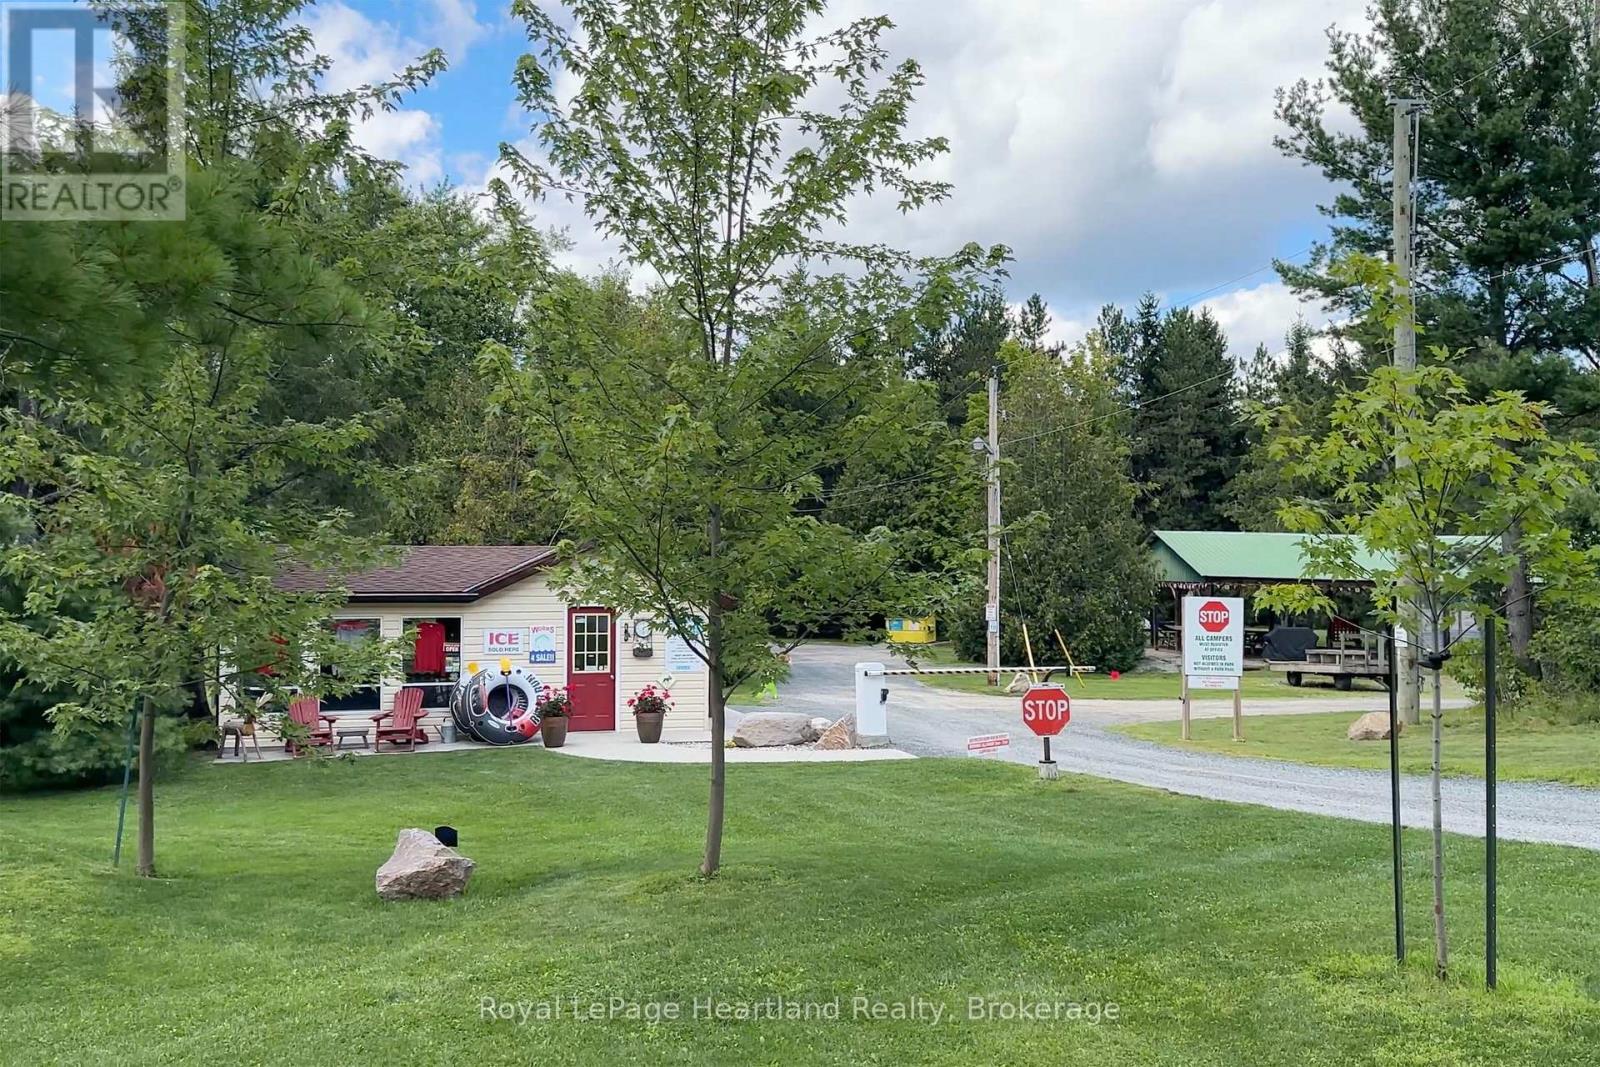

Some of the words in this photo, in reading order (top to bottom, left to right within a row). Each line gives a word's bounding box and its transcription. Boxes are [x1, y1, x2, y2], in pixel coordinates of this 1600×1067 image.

[1200, 610, 1228, 623] STOP
[489, 632, 519, 645] ICE
[1024, 699, 1068, 721] STOP
